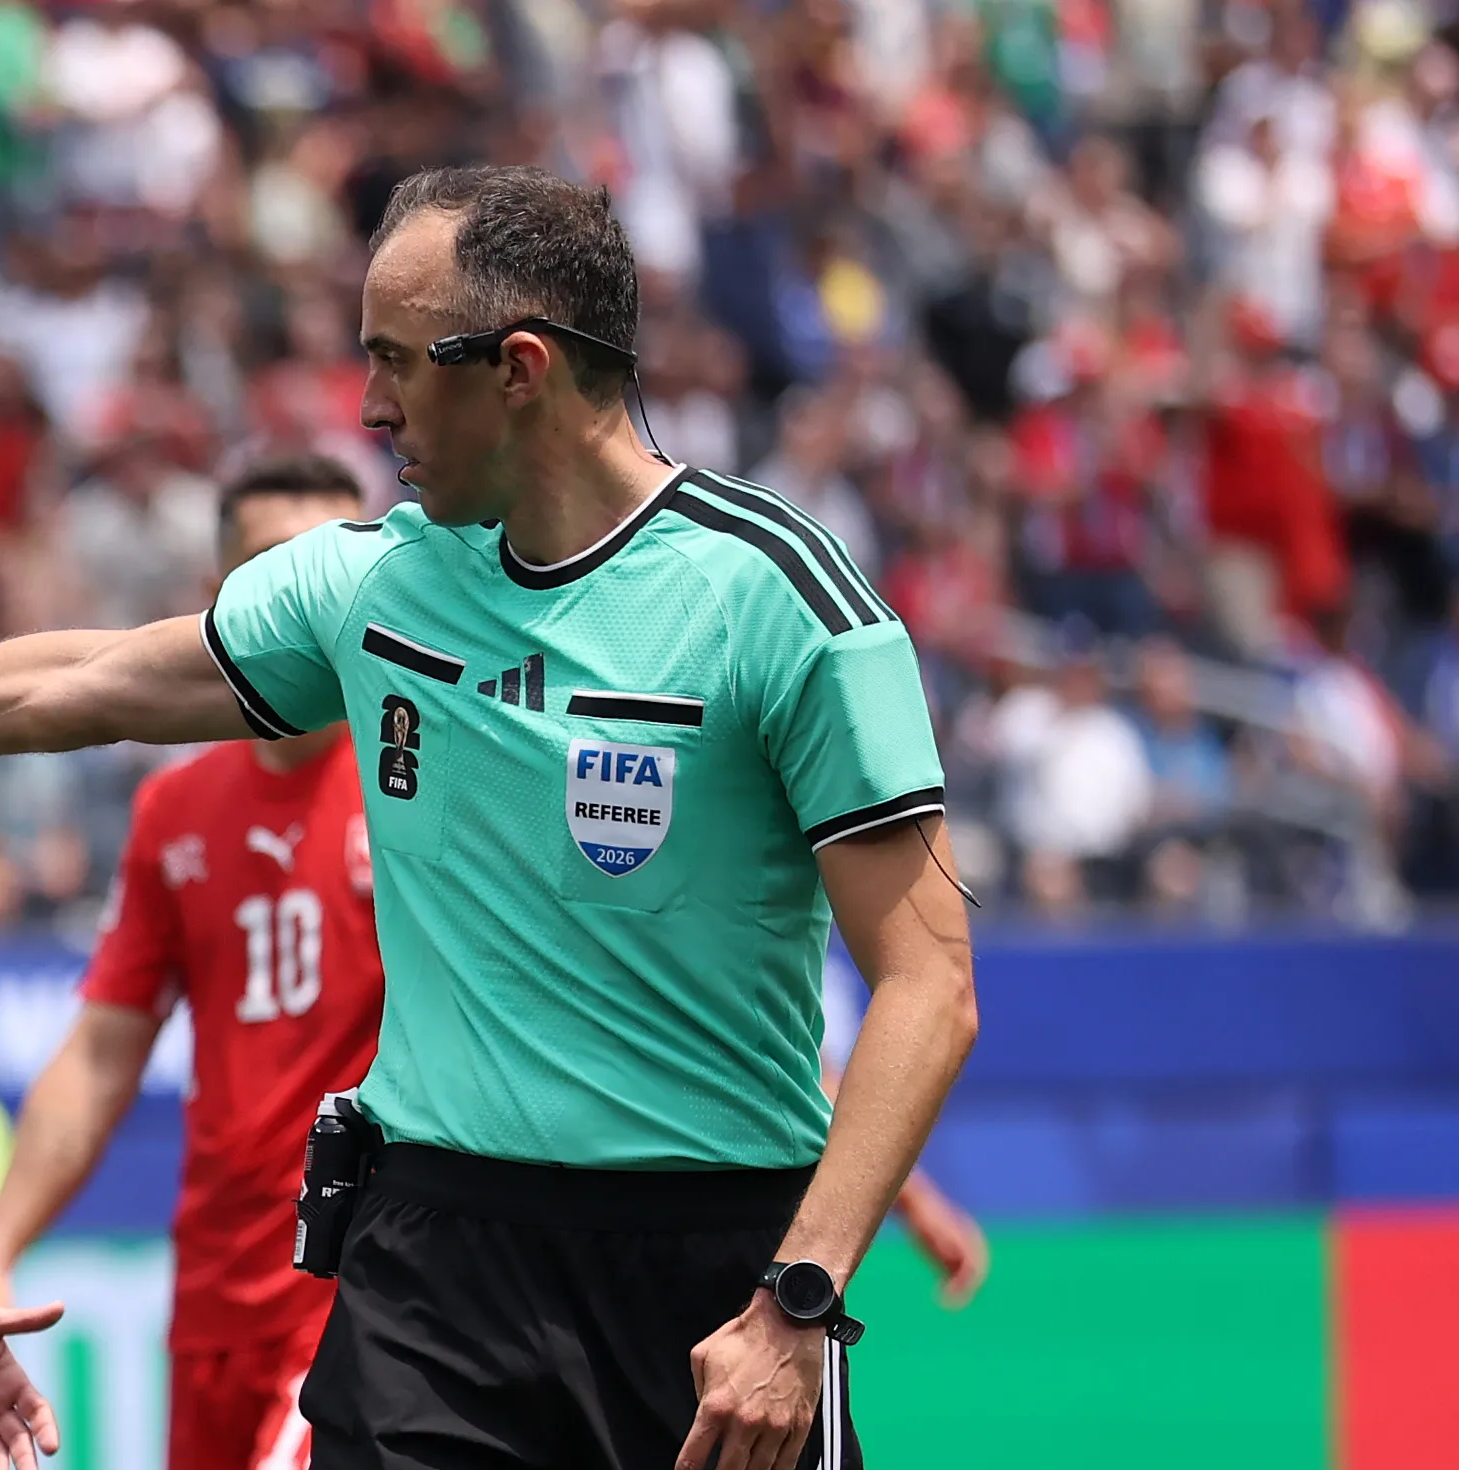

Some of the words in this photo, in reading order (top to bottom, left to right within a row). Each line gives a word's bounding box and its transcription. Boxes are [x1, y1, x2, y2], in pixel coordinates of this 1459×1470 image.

[578, 749, 663, 787] FIFA
[388, 776, 408, 791] FIFA
[575, 802, 661, 826] REFEREE
[596, 848, 635, 865] 2026
[234, 888, 322, 1023] 10
